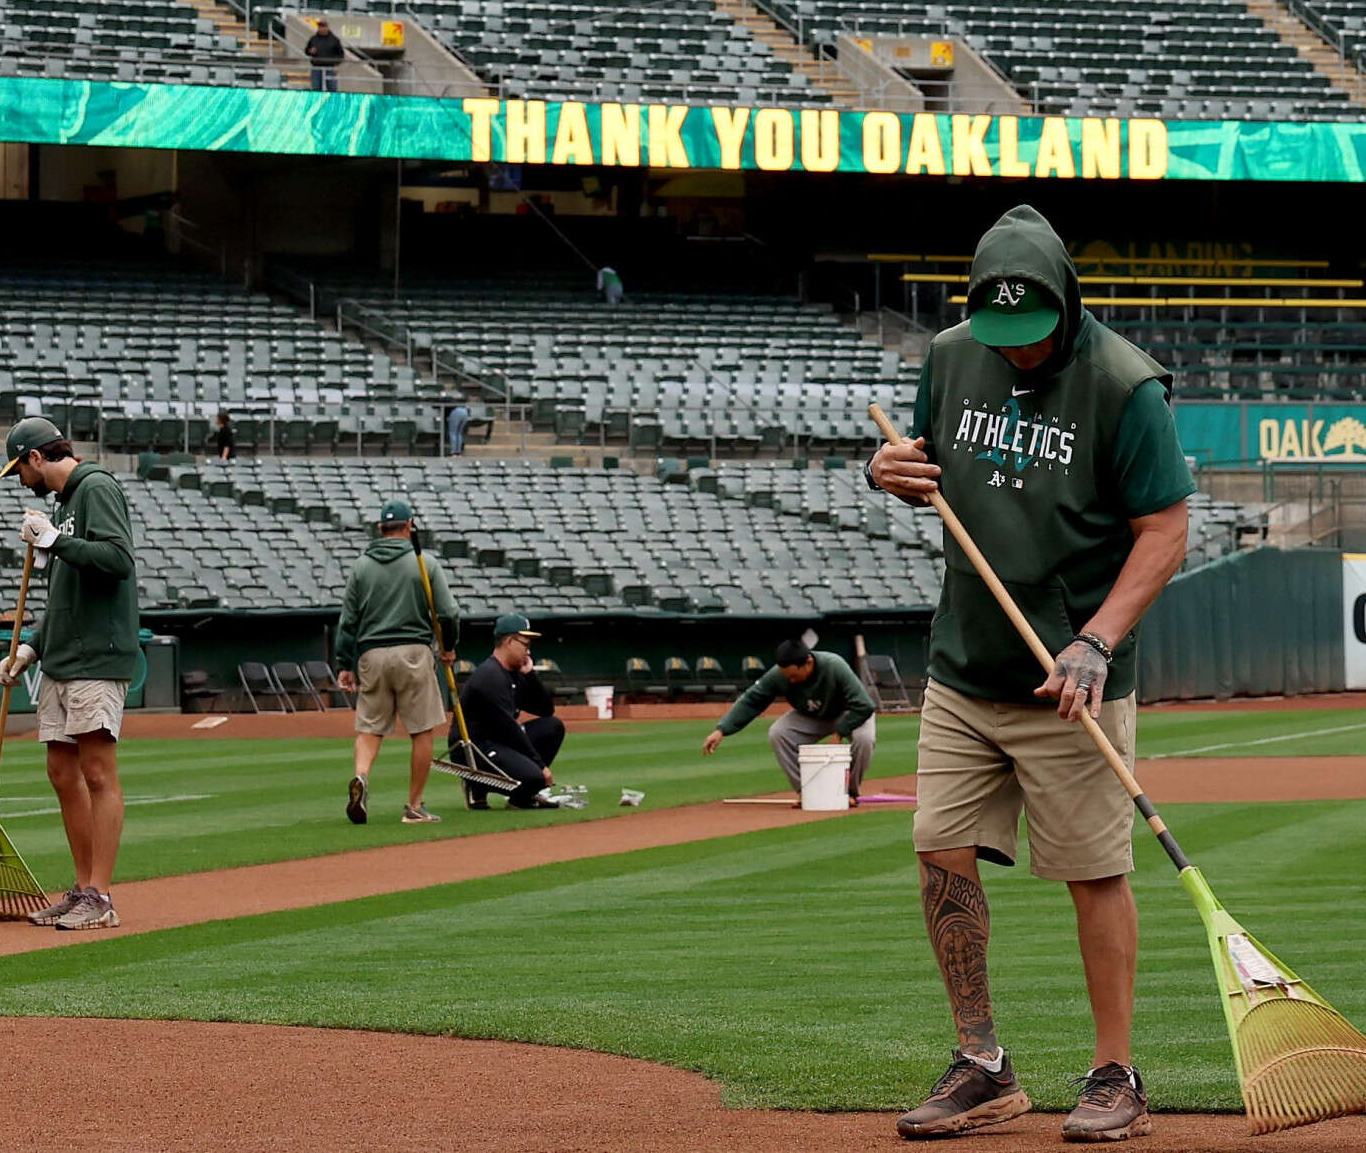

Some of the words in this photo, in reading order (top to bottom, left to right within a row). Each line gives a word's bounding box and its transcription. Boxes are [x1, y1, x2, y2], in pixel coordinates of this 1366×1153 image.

[463, 98, 689, 167] THANK
[712, 107, 839, 172] YOU
[863, 111, 1168, 180] OAKLAND
[991, 279, 1026, 307] A's
[955, 409, 1075, 465] ATHLETICS
[1259, 418, 1325, 458] OAK
